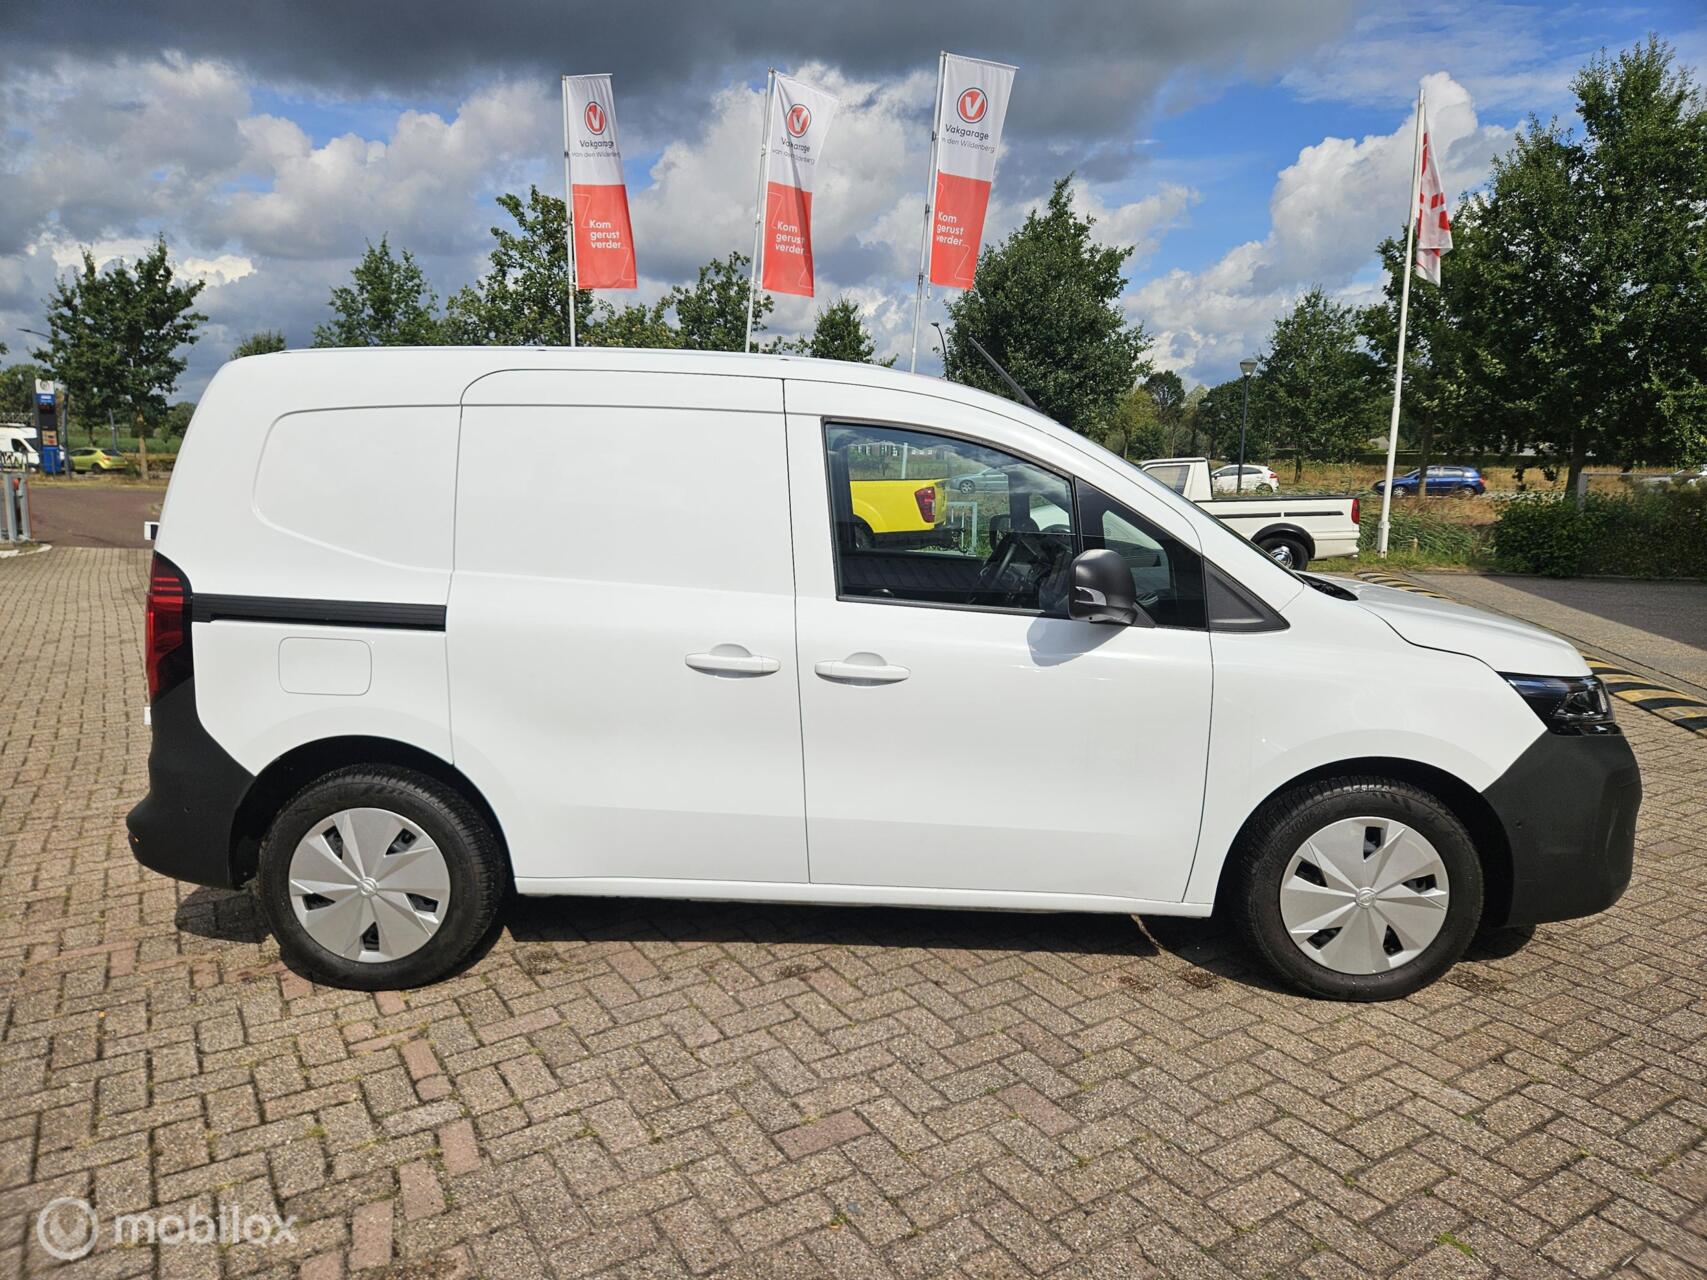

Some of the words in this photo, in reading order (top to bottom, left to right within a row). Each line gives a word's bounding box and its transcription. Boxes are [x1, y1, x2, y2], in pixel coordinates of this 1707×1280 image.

[945, 123, 989, 142] Vakgarage
[938, 211, 957, 223] Kom
[589, 219, 612, 229] Kom
[777, 220, 798, 233] Kom
[590, 230, 620, 241] gerust
[936, 224, 964, 236] gerust
[775, 233, 806, 244] gerust
[936, 235, 964, 246] verder
[590, 240, 621, 249] verder
[775, 243, 806, 255] verder
